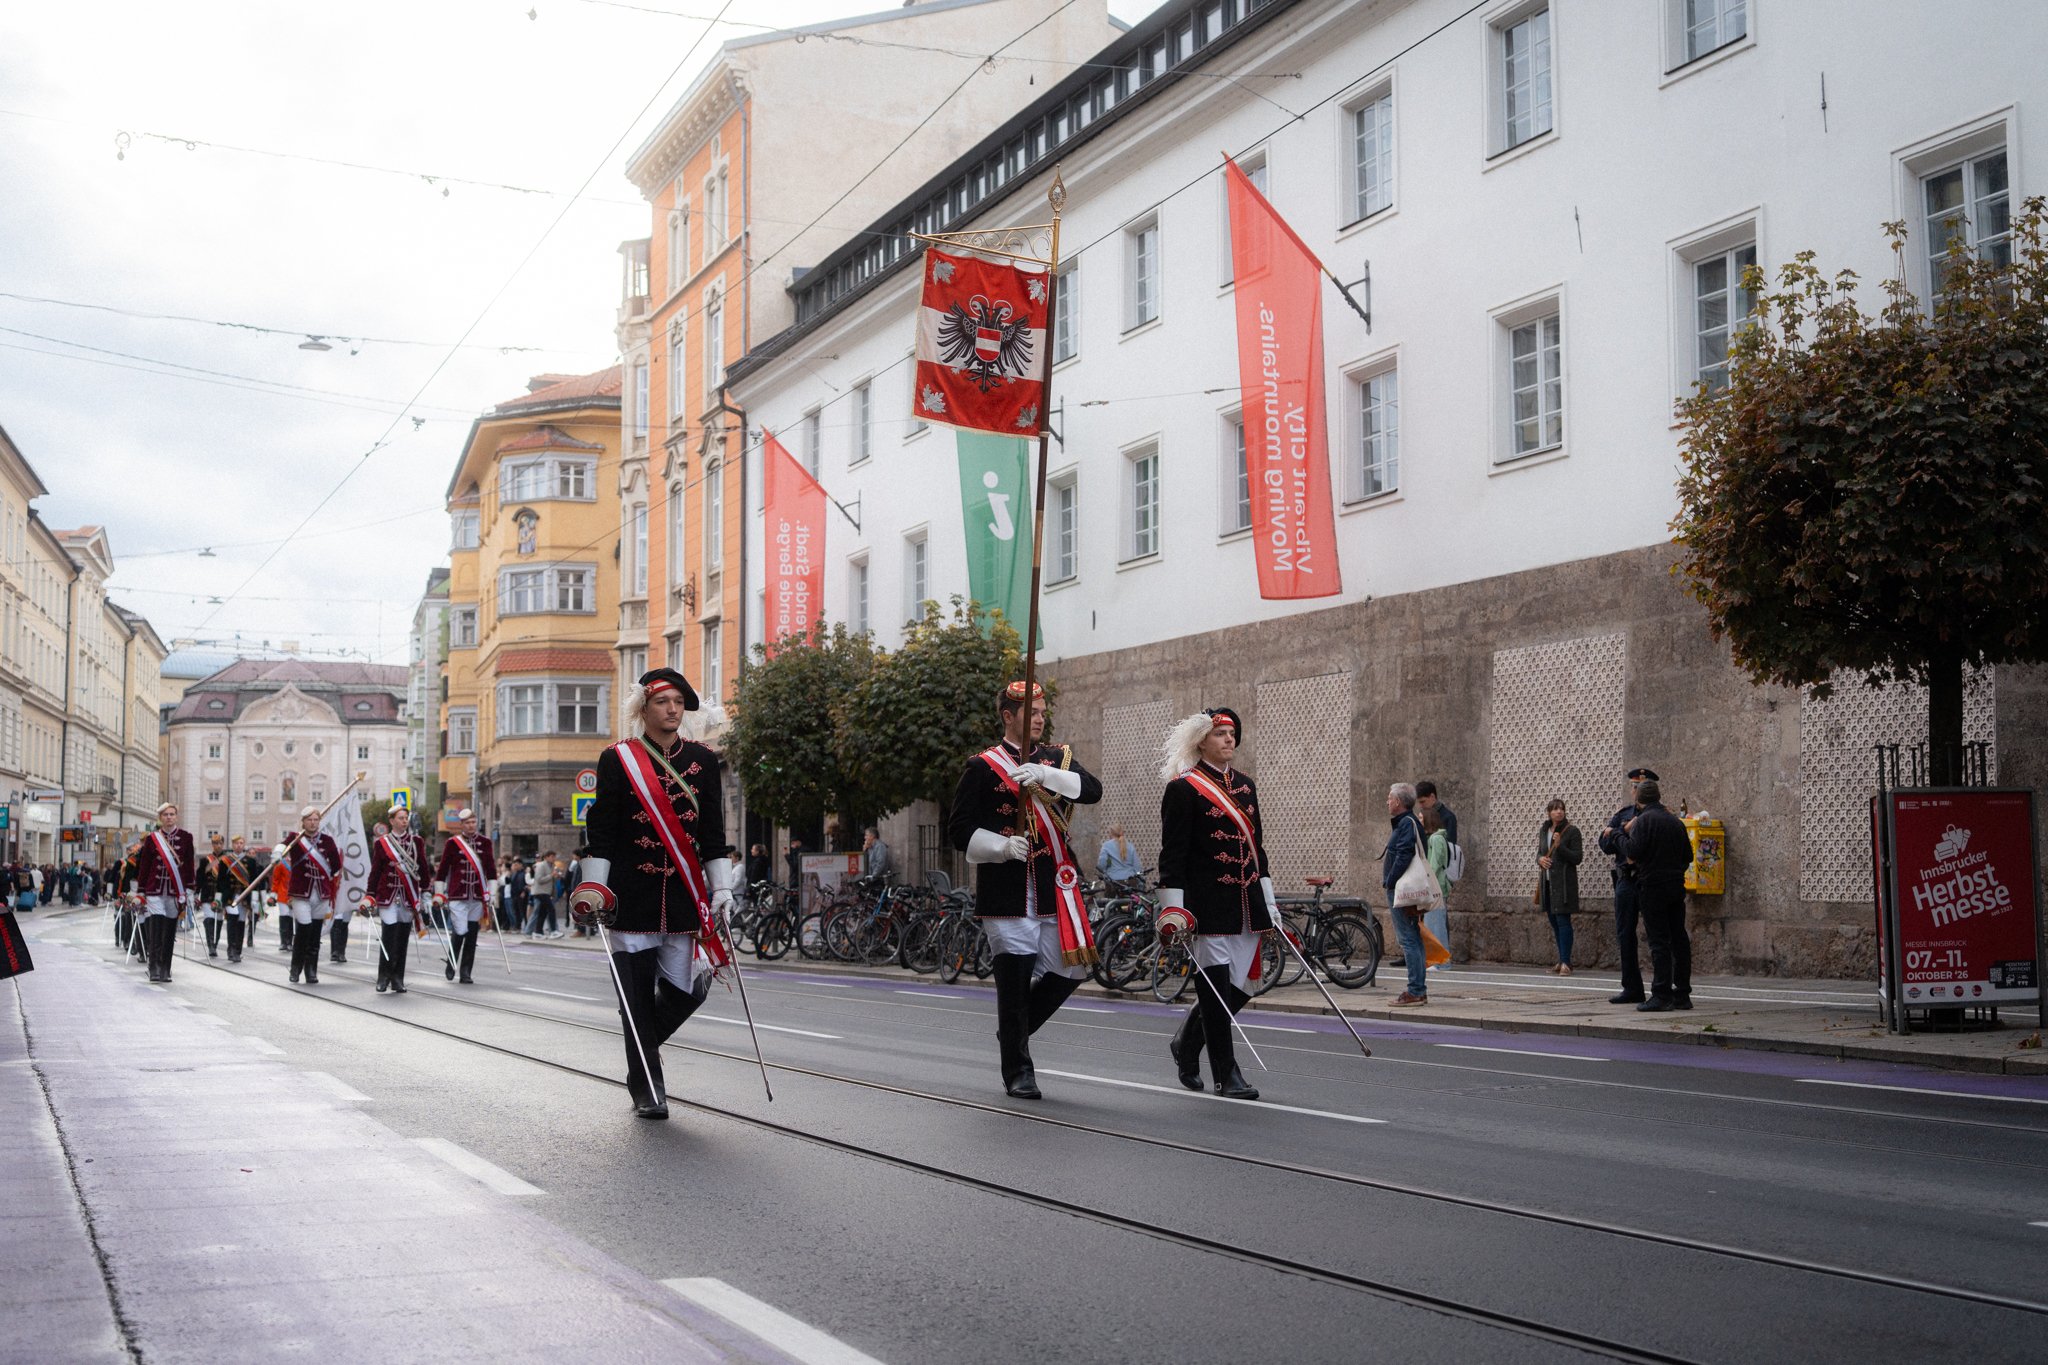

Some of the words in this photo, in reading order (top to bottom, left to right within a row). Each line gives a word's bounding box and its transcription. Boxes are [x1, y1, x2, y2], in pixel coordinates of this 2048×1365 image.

[582, 776, 595, 787] 30
[1920, 850, 1988, 880] Innsbrucker
[1912, 863, 1999, 911] Herbst
[1931, 885, 2010, 928] messe
[1906, 970, 1953, 980] OKTOBER
